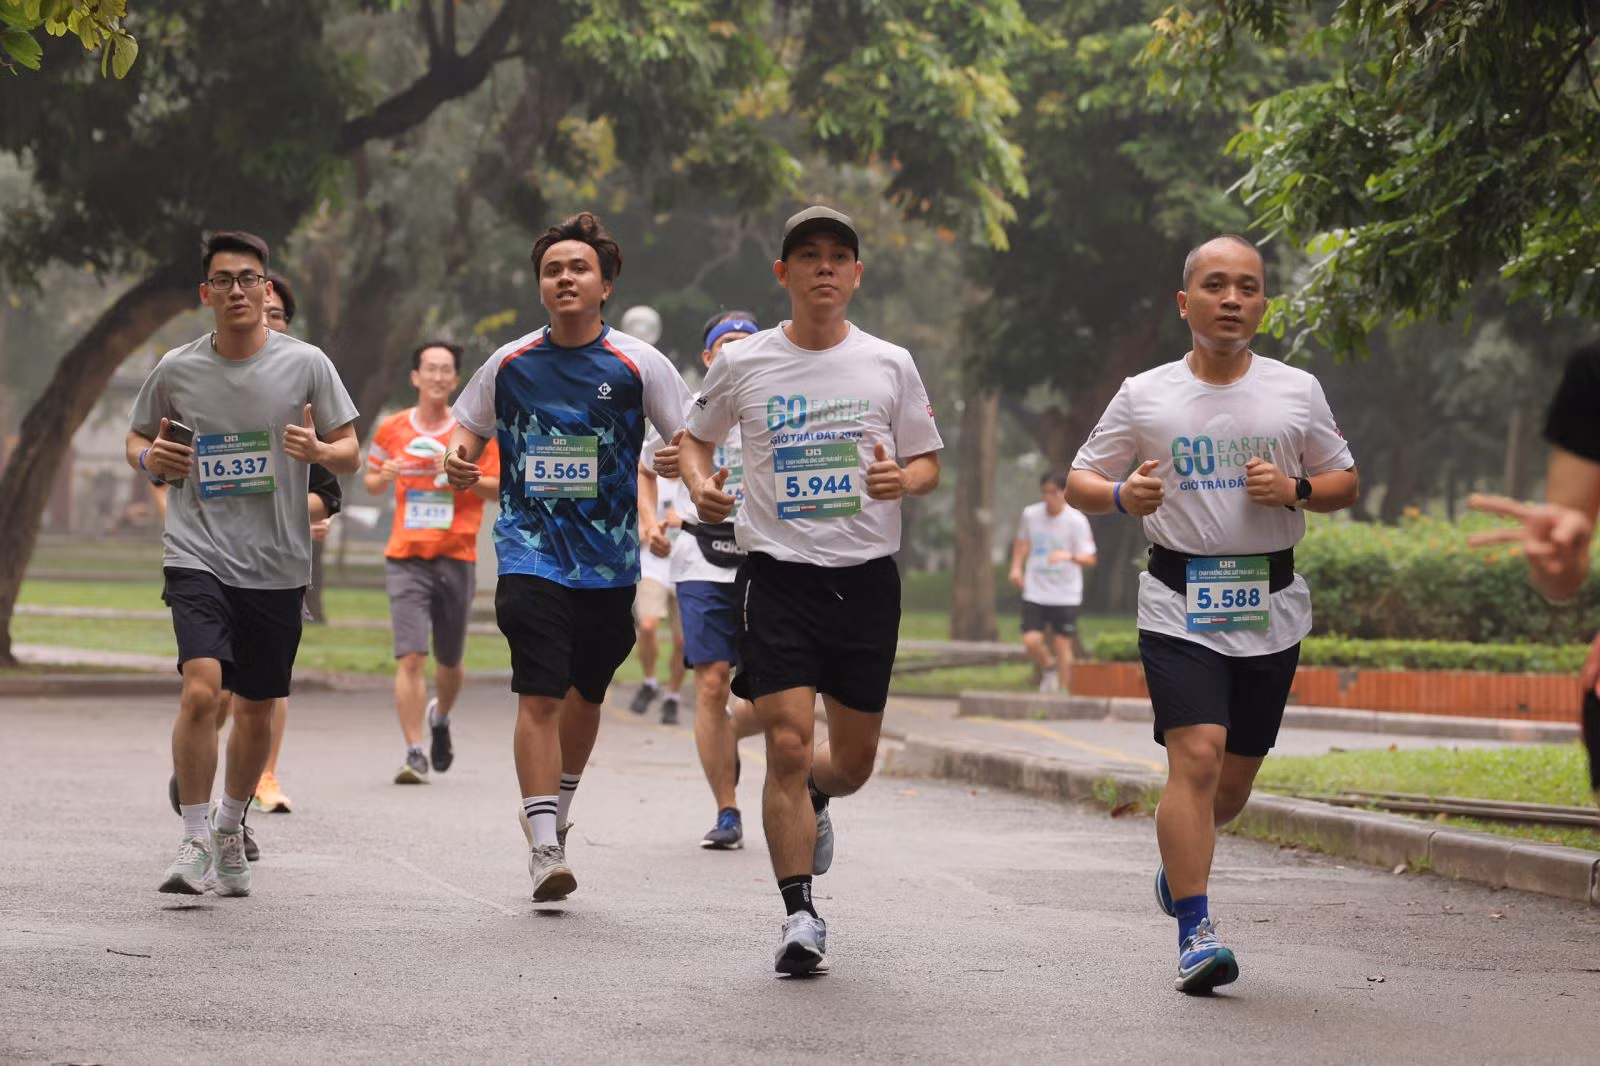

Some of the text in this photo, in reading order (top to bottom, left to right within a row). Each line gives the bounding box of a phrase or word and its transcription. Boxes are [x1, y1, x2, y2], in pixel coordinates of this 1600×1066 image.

[768, 395, 807, 432] 60
[811, 400, 870, 411] EARTH
[1217, 438, 1277, 453] EARTH
[1172, 436, 1214, 476] 60
[202, 457, 267, 476] 16.337
[534, 461, 590, 479] 5.565
[786, 474, 852, 497] 5.944
[1180, 476, 1246, 490] GIỜ TRÁI ĐẤ
[1197, 588, 1260, 609] 5.588
